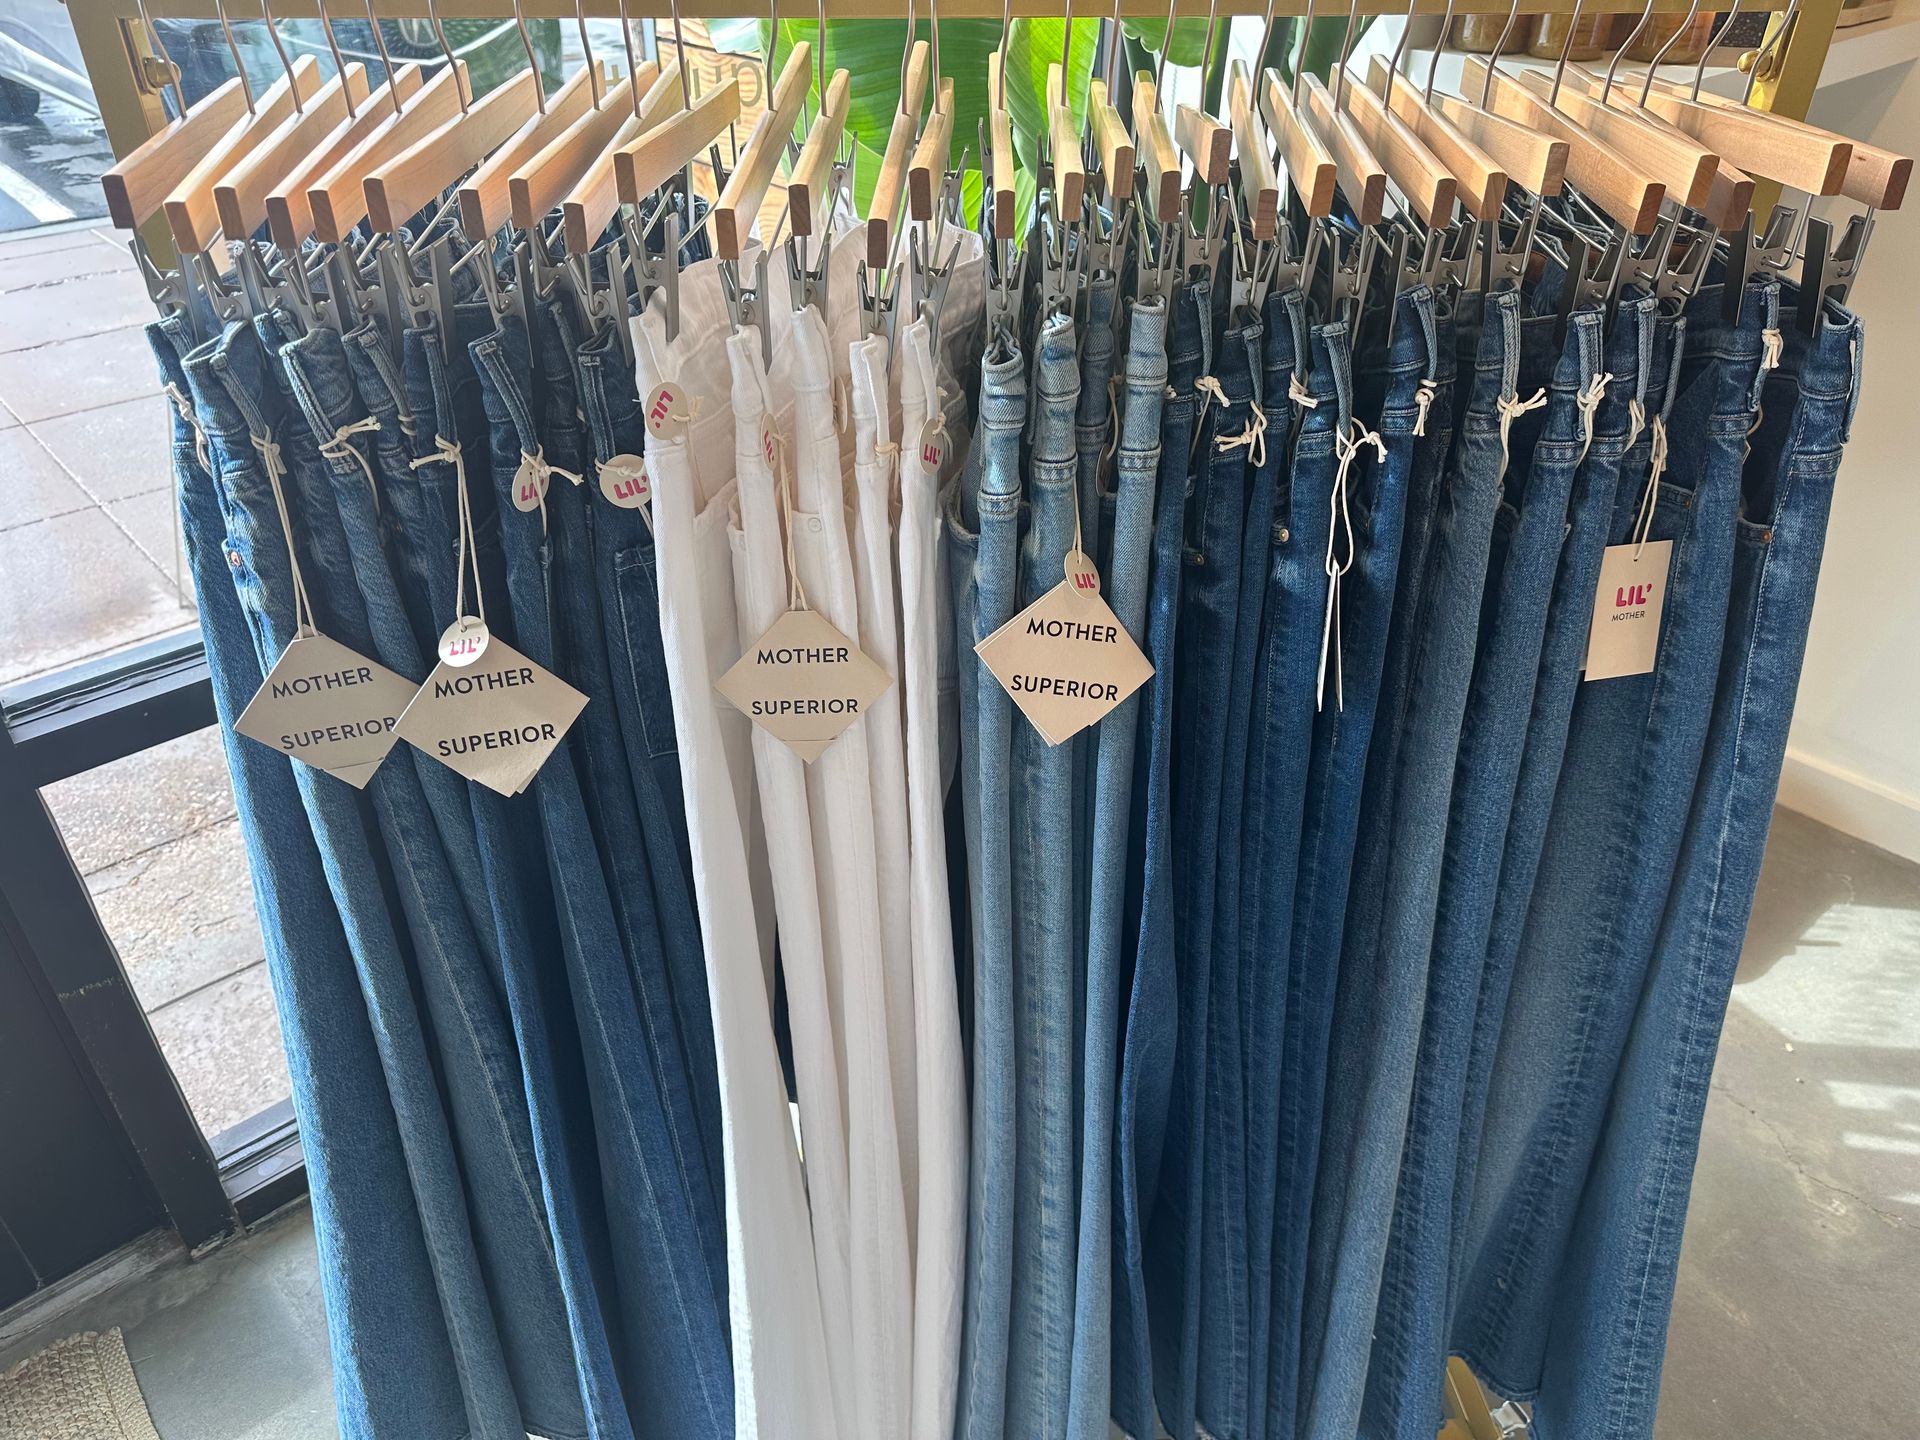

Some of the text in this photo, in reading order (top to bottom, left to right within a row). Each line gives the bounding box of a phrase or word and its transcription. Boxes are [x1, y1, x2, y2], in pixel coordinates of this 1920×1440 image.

[923, 443, 941, 465] LIL'
[613, 475, 647, 500] LIL'
[1074, 573, 1096, 589] LIL'
[1615, 583, 1653, 607] LIL'
[1611, 610, 1646, 622] MOTHER
[1026, 617, 1118, 644] MOTHER
[449, 636, 481, 656] LIL'
[756, 647, 850, 665] MOTHER
[271, 666, 374, 699] MOTHER
[434, 667, 536, 699] MOTHER
[1010, 674, 1118, 701] SUPERIOR
[751, 698, 859, 716] SUPERIOR
[279, 716, 398, 750] SUPERIOR
[437, 723, 557, 757] SUPERIOR
